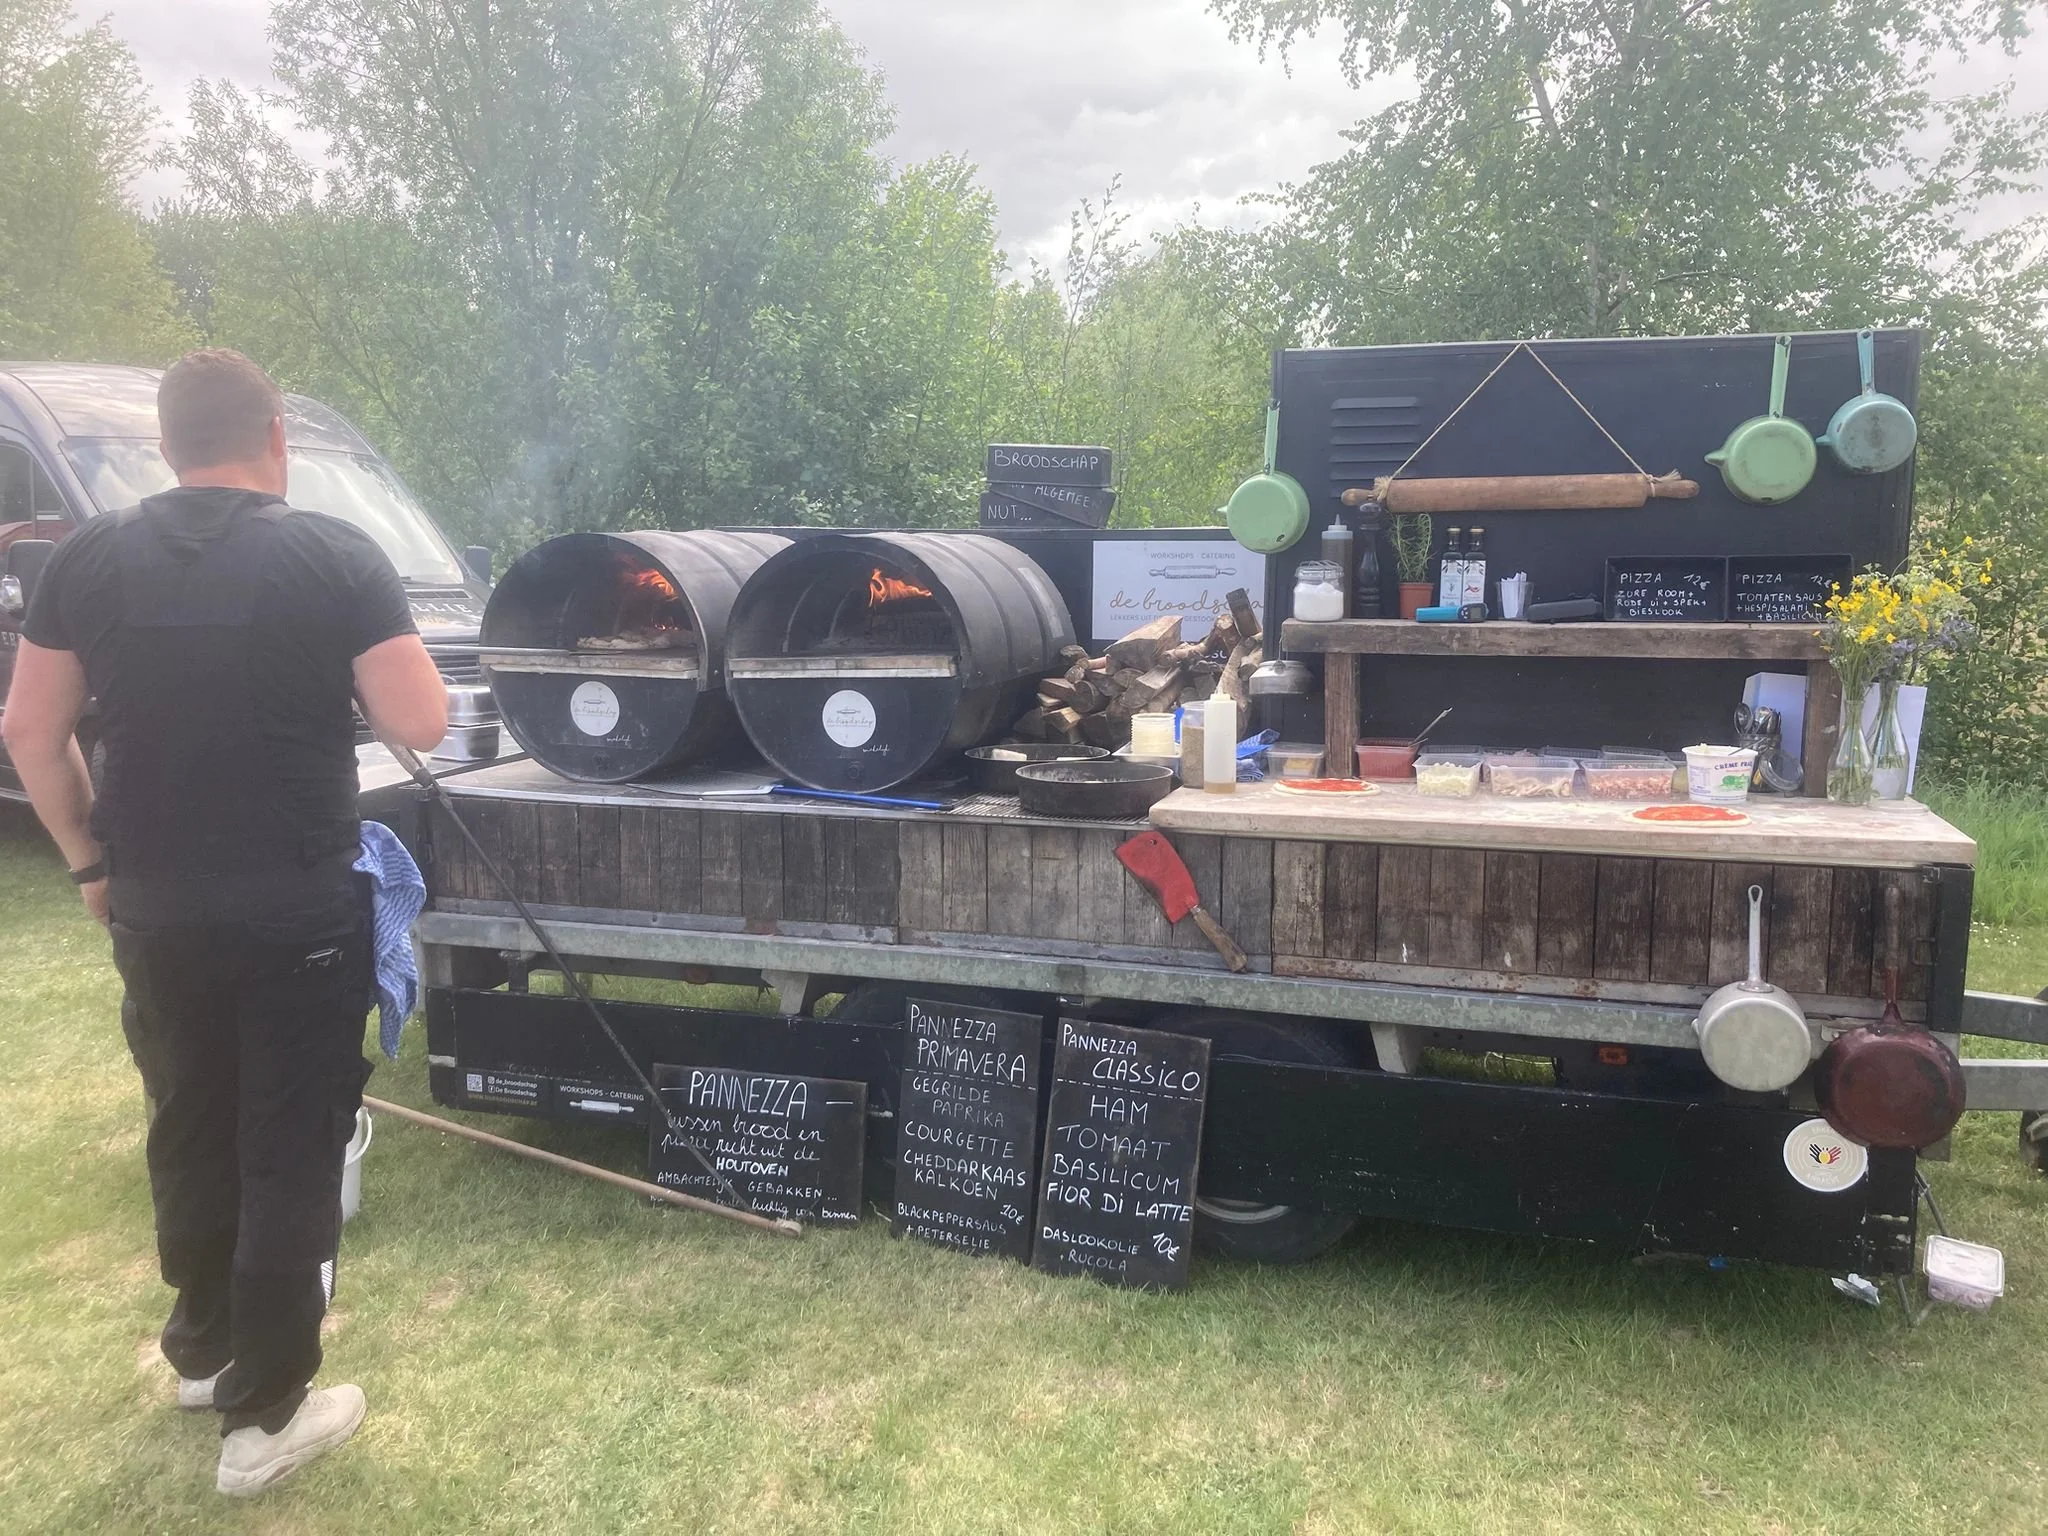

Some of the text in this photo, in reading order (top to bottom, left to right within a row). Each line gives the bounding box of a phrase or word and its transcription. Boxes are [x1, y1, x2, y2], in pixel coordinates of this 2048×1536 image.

[993, 449, 1099, 471] BROODSCHAP
[1620, 572, 1662, 584] PIZZA
[1742, 573, 1782, 585] PIZZA
[1110, 590, 1140, 609] de
[1616, 589, 1648, 598] ZURE
[1657, 590, 1685, 598] ROOM
[1629, 606, 1684, 617] BIESLOOK
[910, 1004, 996, 1044] PANNEZZA
[1063, 1023, 1137, 1056] PANNEZZA
[917, 1038, 1026, 1082] PRIMAVERA
[1092, 1057, 1200, 1091] CLASSICO
[560, 1084, 604, 1097] WORKSHOPS
[609, 1090, 645, 1101] CATERING
[690, 1071, 807, 1120] PANNEZZA
[912, 1077, 991, 1103] GEGRILDE
[933, 1099, 1004, 1128] PAPRIKA
[1090, 1094, 1148, 1125] HAM
[733, 1114, 792, 1140] brood
[798, 1127, 825, 1142] en
[905, 1121, 1014, 1159] COURGETTE
[1057, 1124, 1171, 1160] TOMAAT
[716, 1157, 789, 1177] HOUTOVEN
[904, 1149, 1026, 1186] CHEDDARKAAS
[1053, 1153, 1180, 1195] BASILICUM
[914, 1168, 998, 1200] KALKOEN
[1000, 1204, 1025, 1225] 10€
[1047, 1179, 1092, 1209] FIOR
[1135, 1201, 1193, 1222] LATTE
[898, 1202, 1007, 1235] BLACKPEPPERSAUS
[1043, 1226, 1140, 1255] DASLOOKOLIE
[1153, 1232, 1180, 1262] 10€
[1068, 1249, 1128, 1272] RUCOLA
